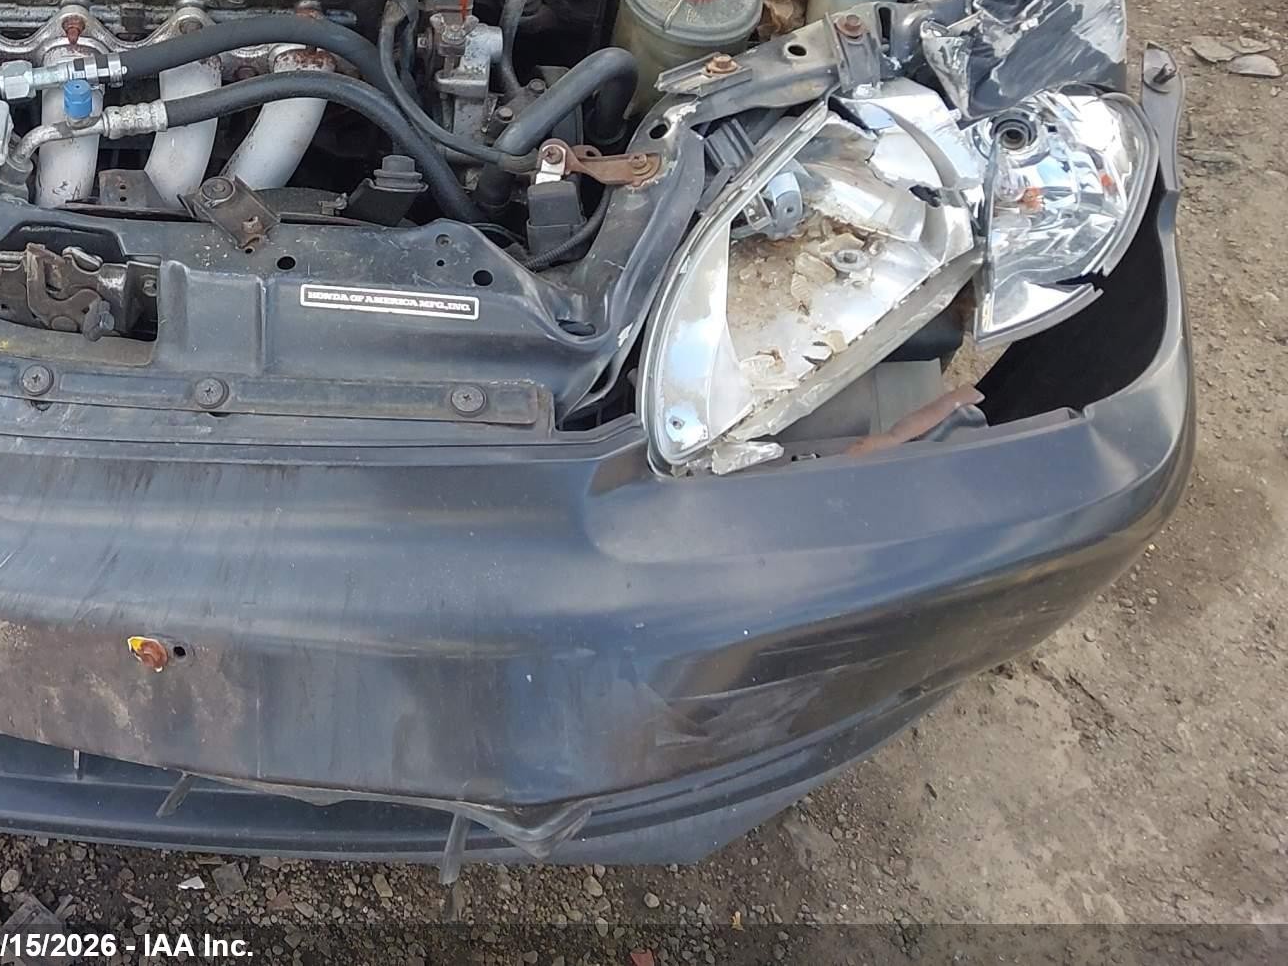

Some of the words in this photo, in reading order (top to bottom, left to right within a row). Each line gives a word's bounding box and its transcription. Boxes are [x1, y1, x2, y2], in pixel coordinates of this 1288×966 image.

[308, 291, 349, 301] HONDA
[350, 294, 364, 302] OF
[365, 296, 417, 306] AMERICA
